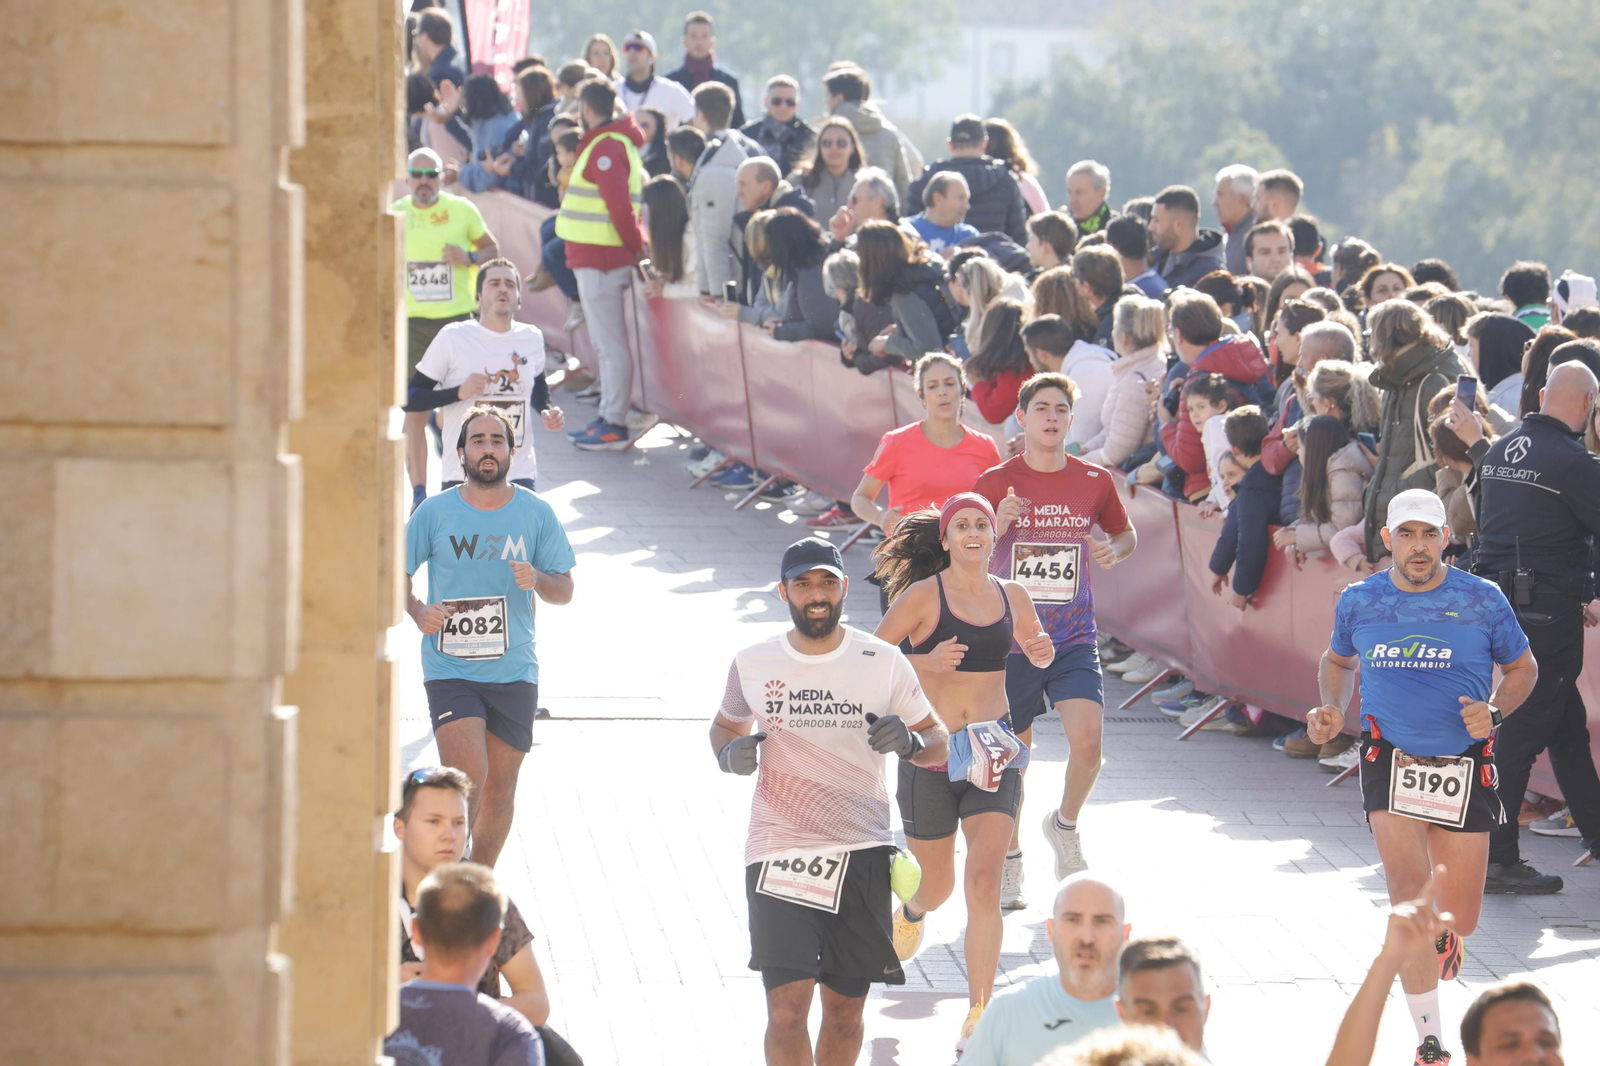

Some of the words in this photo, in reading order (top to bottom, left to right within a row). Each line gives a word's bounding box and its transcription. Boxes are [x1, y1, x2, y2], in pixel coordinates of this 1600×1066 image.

[409, 272, 449, 286] 2648
[1496, 466, 1541, 481] SECURITY
[1034, 504, 1071, 516] MEDIA
[1015, 515, 1031, 528] 36
[1034, 513, 1091, 527] MARATÓN
[1017, 561, 1075, 580] 4456
[444, 616, 503, 636] 4082
[1371, 661, 1452, 669] AUTORECAMBIOS
[788, 689, 834, 701] MEDIA
[765, 701, 784, 714] 37
[789, 699, 863, 715] MARATÓN
[789, 718, 838, 728] CÓRDOBA
[840, 719, 863, 729] 2023
[1401, 768, 1461, 798] 5190
[771, 855, 840, 881] 4667
